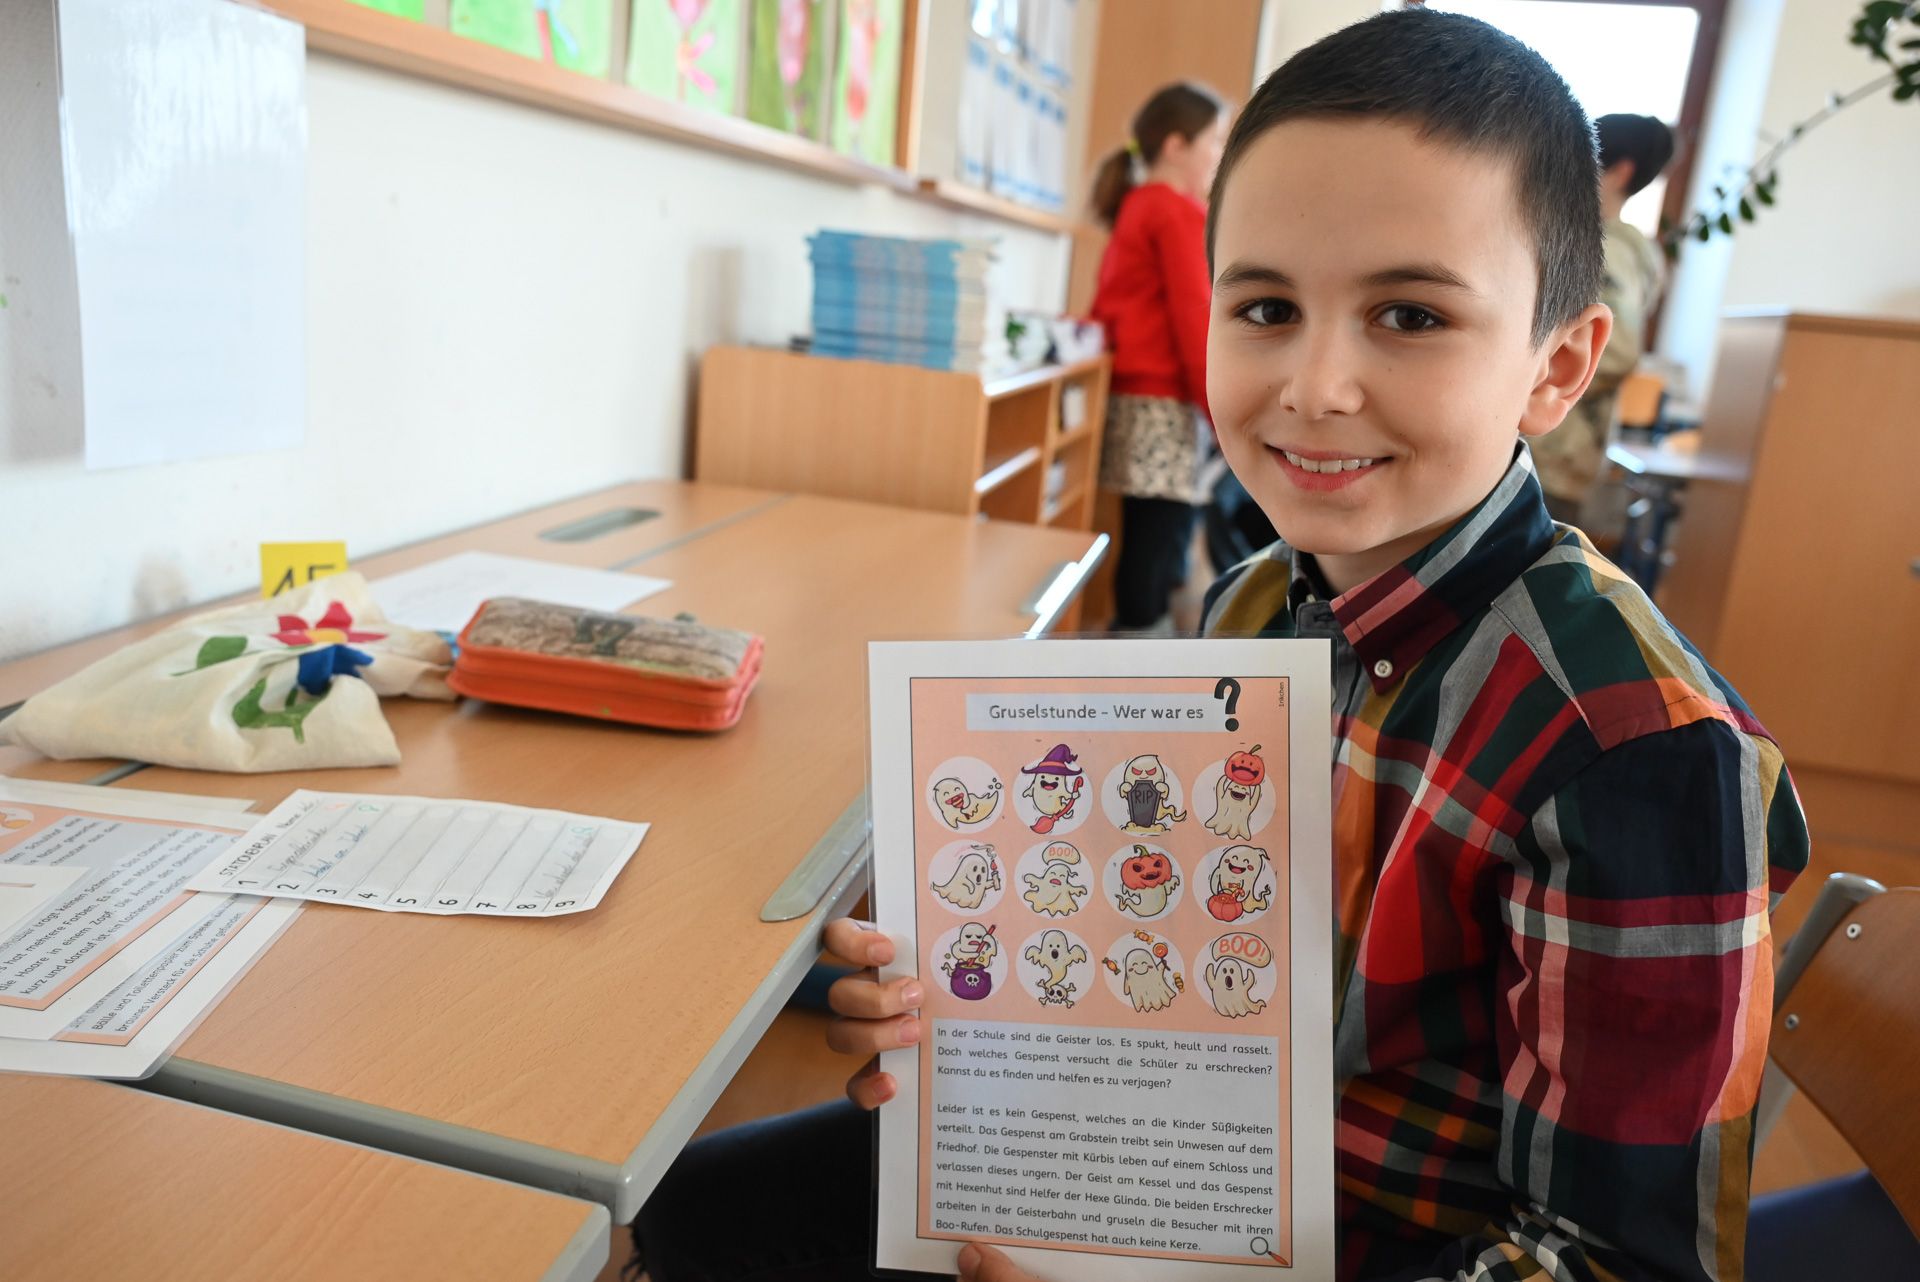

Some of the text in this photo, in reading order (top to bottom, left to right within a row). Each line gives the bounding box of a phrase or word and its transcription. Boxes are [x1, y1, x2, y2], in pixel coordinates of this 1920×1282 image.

[989, 703, 1096, 718] Gruselstunde
[1113, 704, 1146, 718] Wer
[1150, 708, 1181, 719] war
[1186, 708, 1203, 719] es
[1214, 677, 1241, 732] ?
[1135, 790, 1153, 804] RIP
[1048, 847, 1073, 856] BOO!
[55, 894, 88, 912] keinen
[439, 898, 458, 906] 6
[555, 900, 576, 908] 9
[3, 953, 27, 964] hat
[26, 926, 66, 951] mehrere
[63, 904, 100, 925] Farben.
[15, 957, 50, 977] Haare
[62, 927, 92, 946] einem
[89, 910, 117, 925] Zopf.
[1219, 935, 1266, 961] BOO!
[19, 979, 47, 994] kurz
[45, 965, 68, 978] und
[65, 941, 97, 964] darauf
[94, 933, 110, 942] ist
[91, 1012, 117, 1030] Bälle
[114, 998, 131, 1014] und
[115, 1005, 150, 1032] braunes
[147, 975, 175, 1006] Versteck
[172, 967, 185, 978] für
[937, 1027, 1271, 1055] In der Schule sind die Geister los. Es spukt, heult und rasselt.
[937, 1046, 1272, 1074] Doch welches Gespenst versucht die Schüler zu erschrecken?
[937, 1065, 971, 1076] Kannst
[973, 1067, 986, 1077] du
[1002, 1068, 1033, 1080] finden
[1036, 1072, 1055, 1081] und
[1058, 1072, 1090, 1083] helfen
[1092, 1076, 1104, 1084] es
[1106, 1077, 1118, 1085] zu
[1121, 1076, 1171, 1089] verjagen?
[937, 1103, 1272, 1135] Leider ist es kein Gespenst, welches an die Kinder Süßigkeiten
[936, 1124, 1272, 1154] verteilt. Das Gespenst am Grabstein treibt sein Unwesen auf dem
[936, 1141, 1272, 1175] Friedhof. Die Gespenster mit Kürbis leben auf einem Schloss und
[936, 1161, 1272, 1196] verlassen dieses ungern. Der Geist am Kessel und das Gespenst
[936, 1181, 1273, 1215] mit Hexenhut sind Helfer der Hexe Glinda. Die beiden Erschrecker
[936, 1200, 1273, 1235] arbeiten in der Geisterbahn und gruseln die Besucher mit ihren
[936, 1219, 1200, 1250] Boo-Rufen. Das Schulgespenst hat auch keine Kerze.
